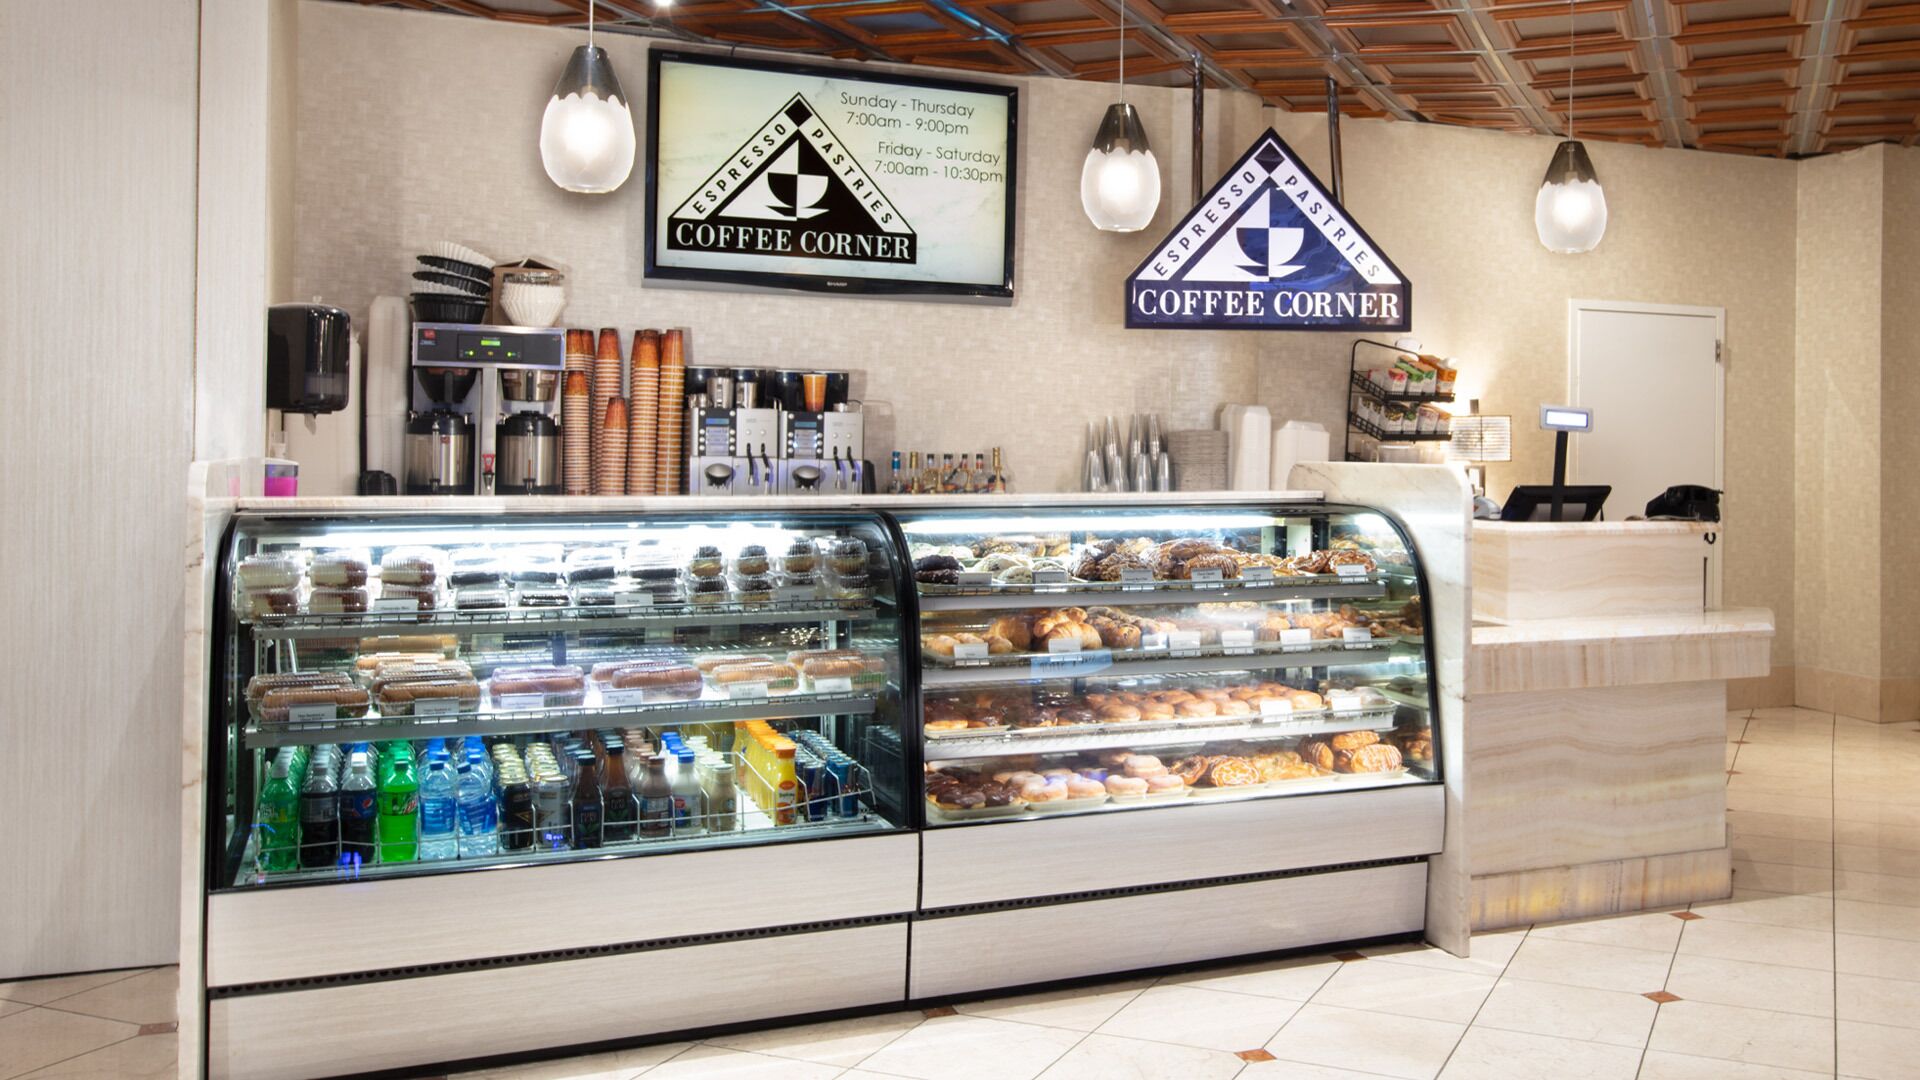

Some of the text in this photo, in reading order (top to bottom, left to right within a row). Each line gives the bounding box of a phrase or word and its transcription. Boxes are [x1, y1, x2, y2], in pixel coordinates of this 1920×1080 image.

[840, 91, 897, 112] Sunday
[911, 98, 974, 119] Thursday
[846, 111, 901, 129] 7:00am
[915, 117, 969, 135] 9:00pm
[692, 123, 786, 214] ESPRESSO
[878, 141, 922, 160] Friday
[936, 146, 1000, 167] Saturday
[811, 129, 892, 225] PASTRIES
[874, 159, 929, 177] 7:00am
[943, 165, 1003, 184] 10:30pm
[1154, 170, 1256, 277] ESPRESSO
[1284, 175, 1380, 277] PASTRIES
[676, 222, 911, 260] COFFEE CORNER
[1138, 288, 1400, 319] COFFEE CORNER
